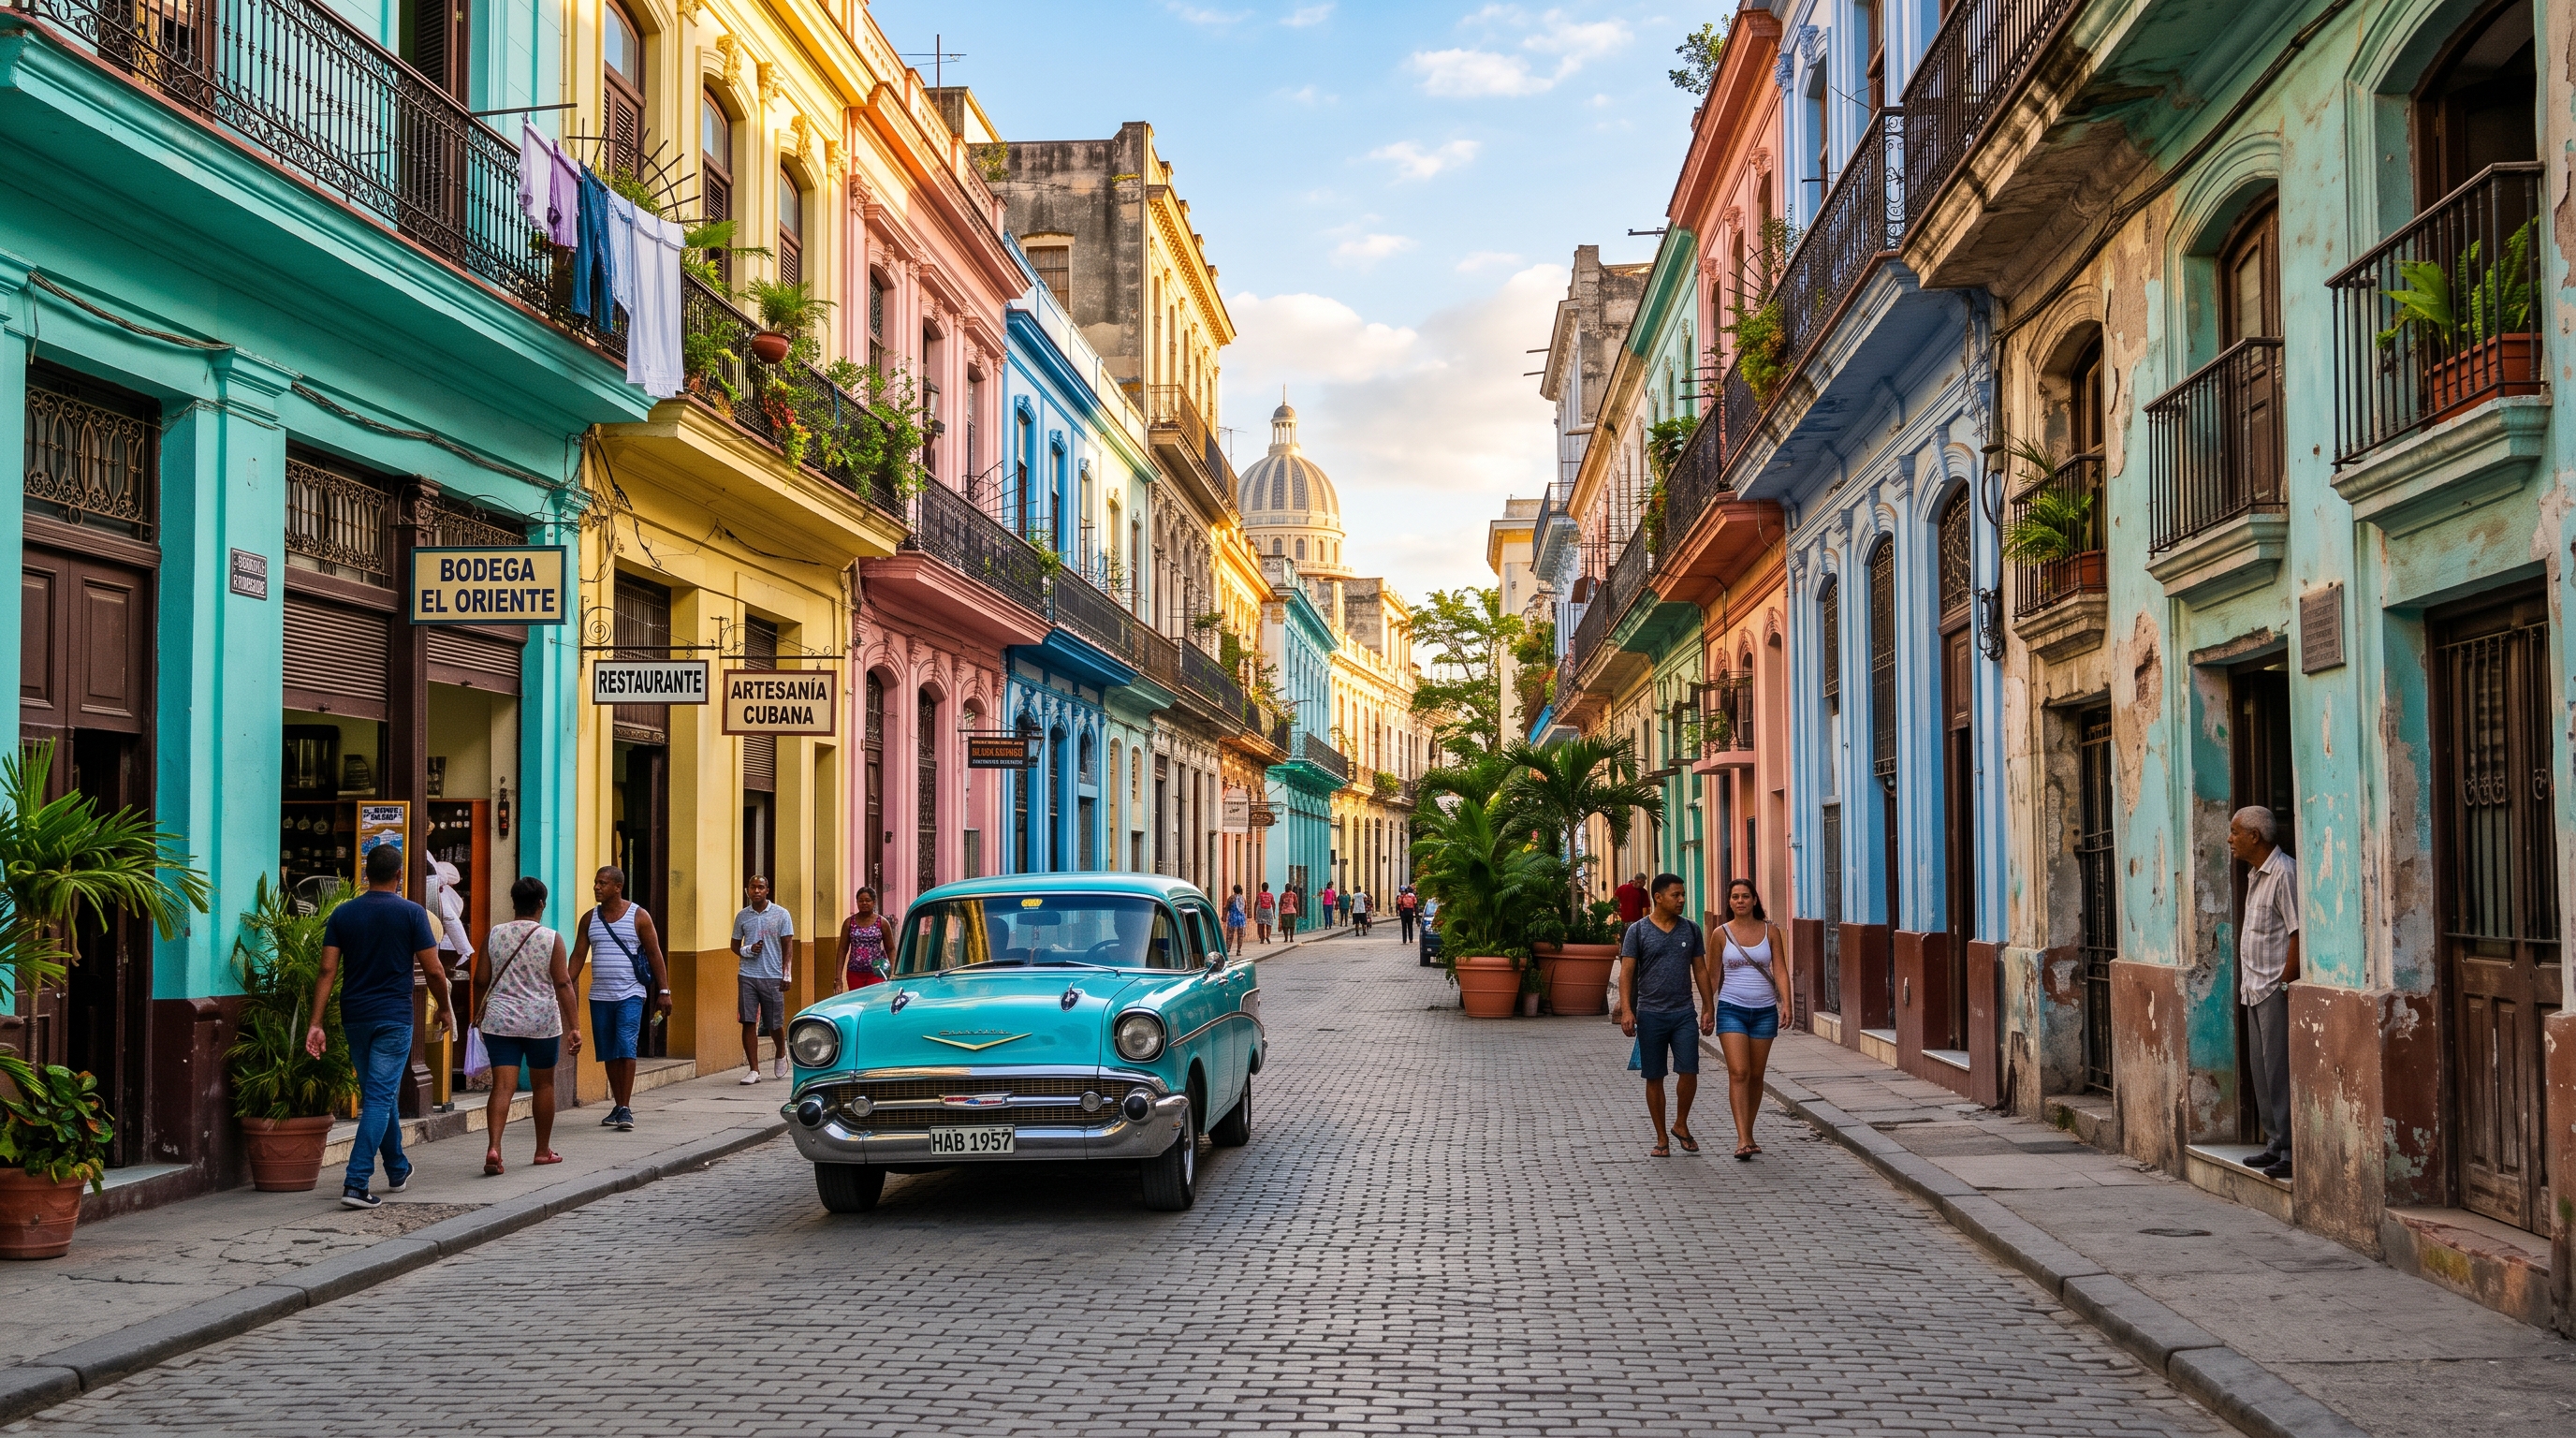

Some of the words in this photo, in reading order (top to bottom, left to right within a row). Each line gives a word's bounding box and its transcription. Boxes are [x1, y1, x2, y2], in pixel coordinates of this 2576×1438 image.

[440, 557, 536, 582] BODEGA
[421, 589, 448, 613] EL
[455, 588, 555, 613] ORIENTE
[598, 669, 702, 694] RESTAURANTE
[730, 677, 827, 700] ARTESANÍA
[743, 705, 814, 725] CUBANA
[931, 1133, 965, 1152] HAB
[969, 1132, 1012, 1151] 1957
